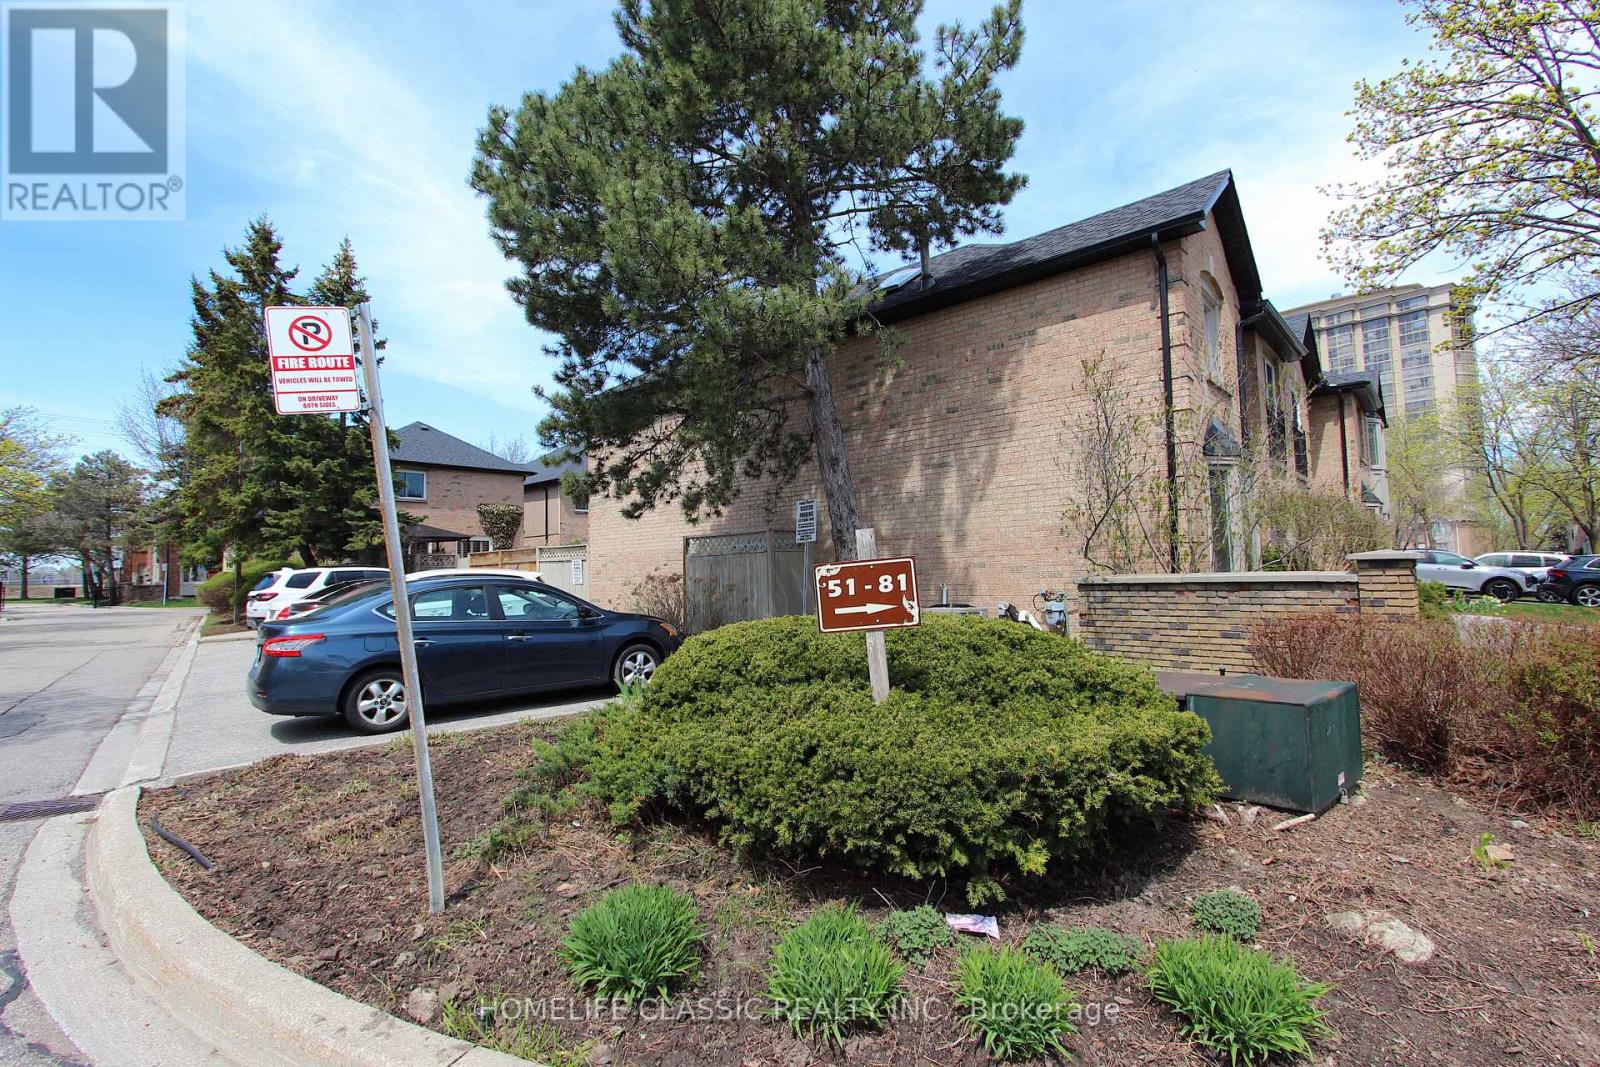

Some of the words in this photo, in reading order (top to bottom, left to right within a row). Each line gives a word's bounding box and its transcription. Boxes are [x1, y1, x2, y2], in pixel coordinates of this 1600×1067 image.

[277, 357, 306, 369] FIRE
[308, 356, 350, 368] ROUTE
[278, 376, 307, 384] VEHICLES
[828, 578, 855, 597] 51
[878, 574, 907, 592] 81
